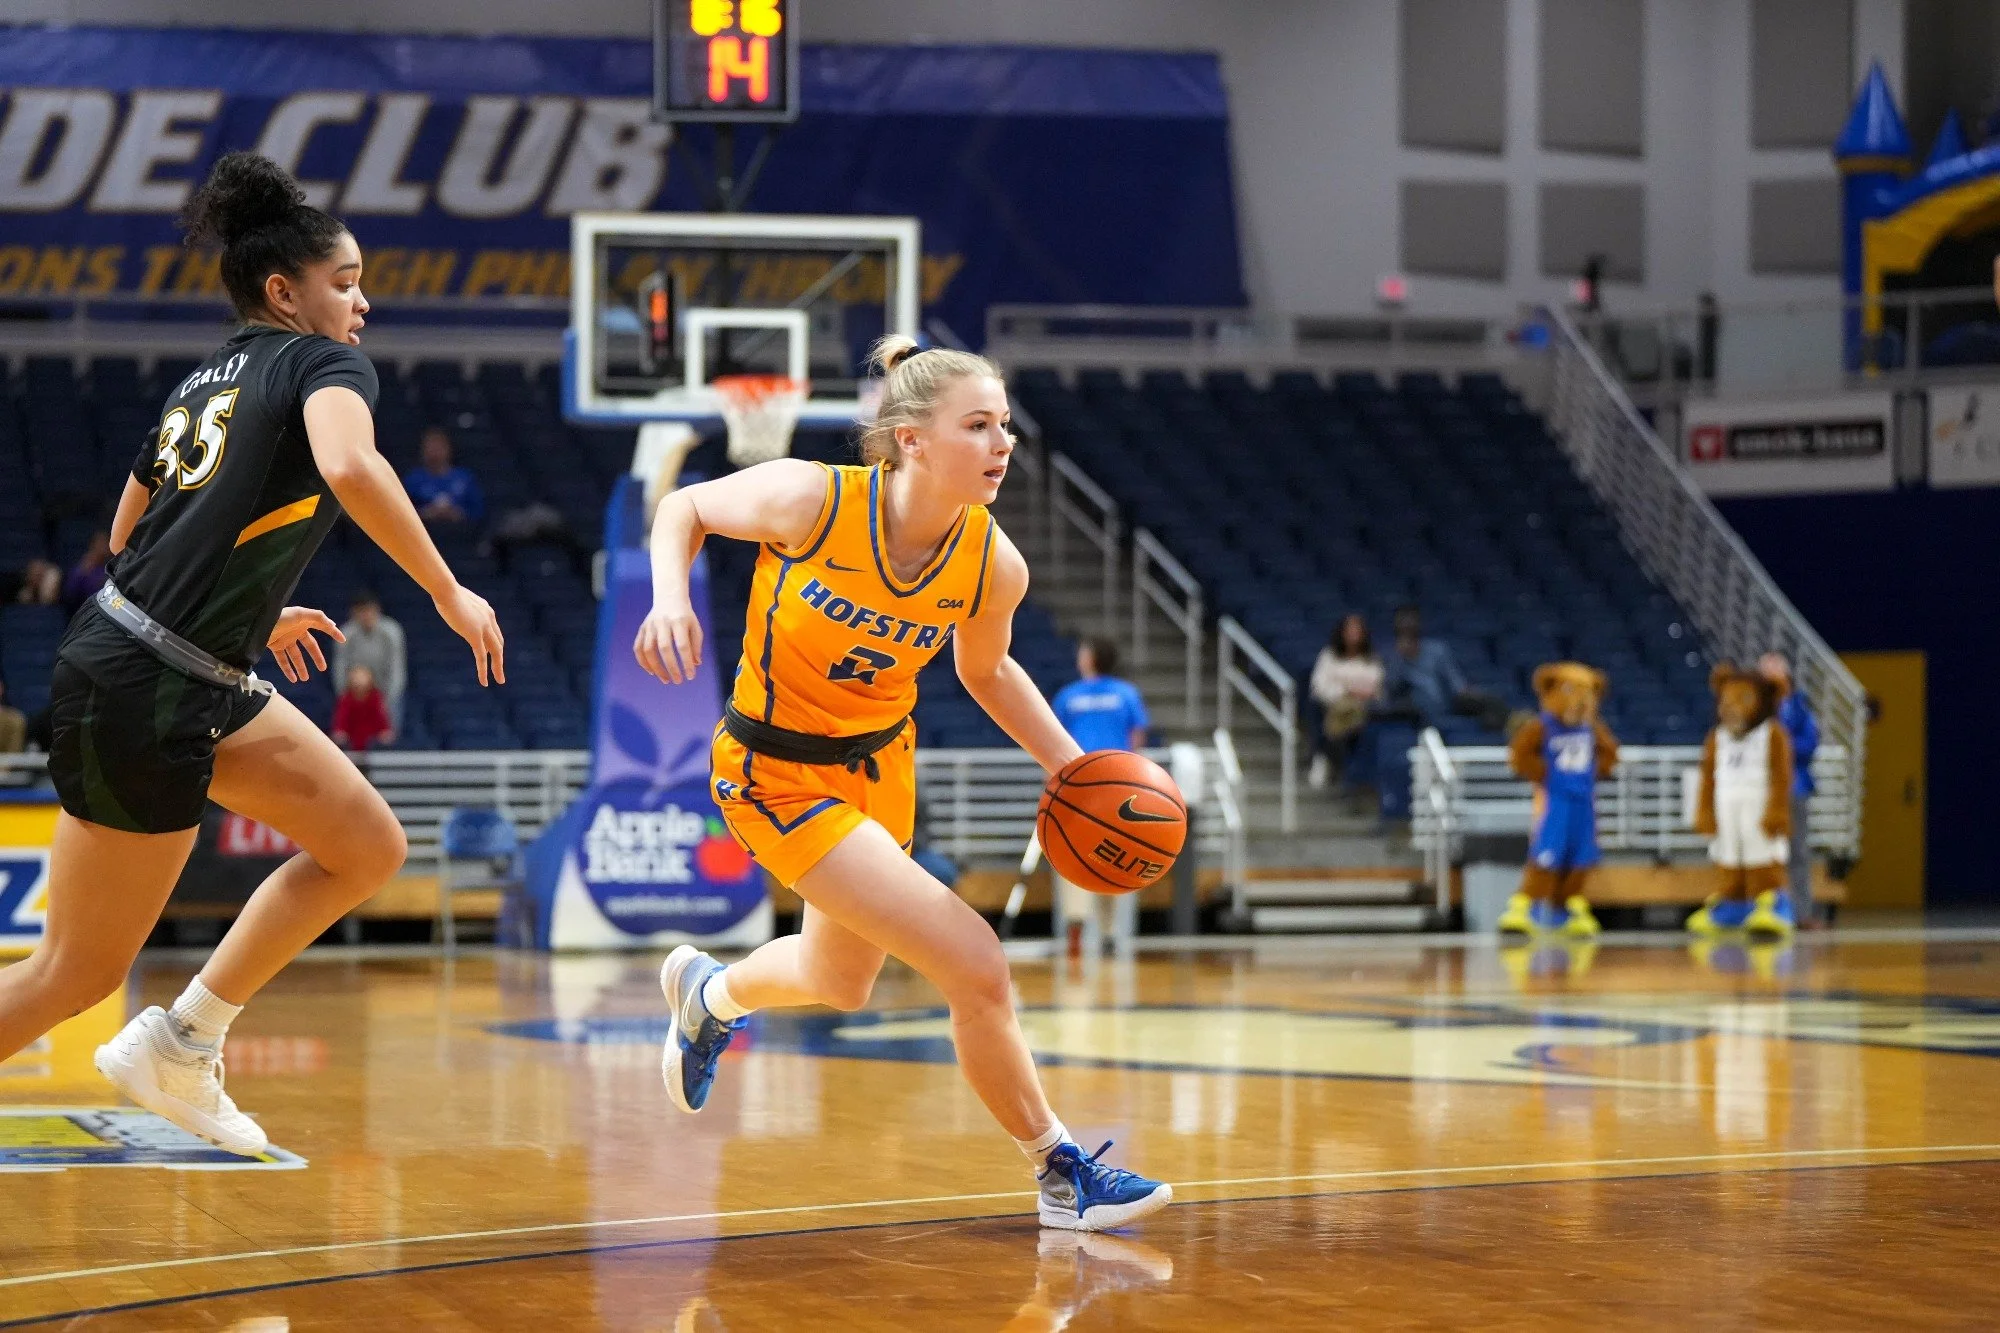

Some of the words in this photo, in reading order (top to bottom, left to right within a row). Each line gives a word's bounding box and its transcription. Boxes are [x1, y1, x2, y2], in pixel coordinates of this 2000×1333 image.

[708, 35, 769, 102] 14
[254, 92, 674, 217] CLUB
[151, 387, 240, 490] 35
[937, 598, 965, 609] CAA
[584, 803, 704, 850] Apple
[586, 839, 693, 884] Bank
[1093, 838, 1164, 879] ELITE
